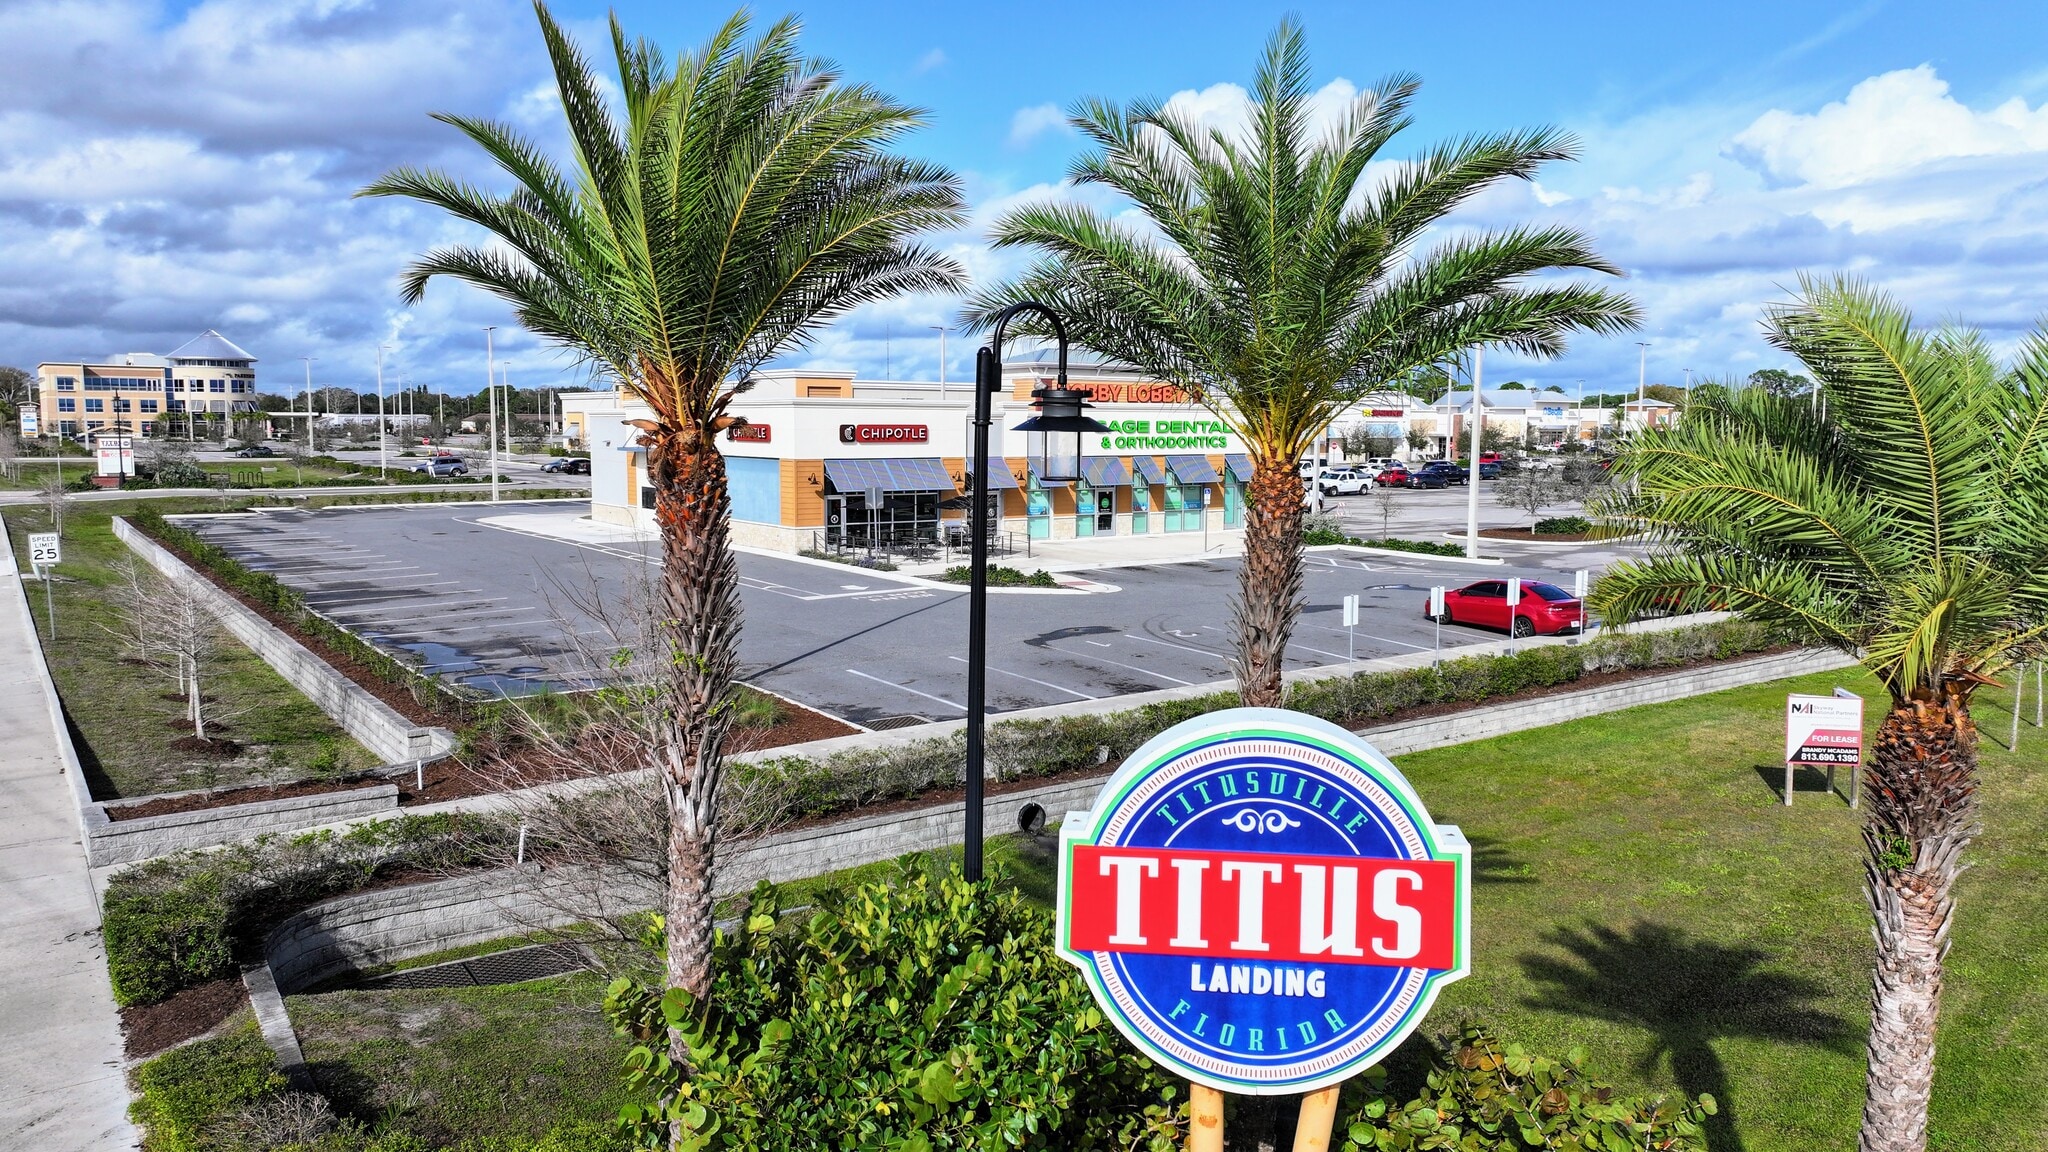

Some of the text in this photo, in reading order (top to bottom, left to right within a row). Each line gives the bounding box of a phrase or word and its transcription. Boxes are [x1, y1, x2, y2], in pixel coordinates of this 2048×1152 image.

[1126, 384, 1185, 403] LOBBY
[861, 428, 926, 439] CHIPOTLE
[1156, 420, 1234, 434] DENTAL
[1101, 436, 1228, 449] & ORTHODONTICS
[34, 549, 57, 560] 25
[1792, 702, 1813, 714] NAI
[1812, 735, 1858, 744] FOR LEASE
[1801, 753, 1858, 762] 813.690.1390
[1156, 771, 1370, 836] TITUSVILLE
[1099, 856, 1423, 960] TITUS
[1190, 964, 1326, 998] LANDING
[1168, 998, 1347, 1052] FLORIDA
